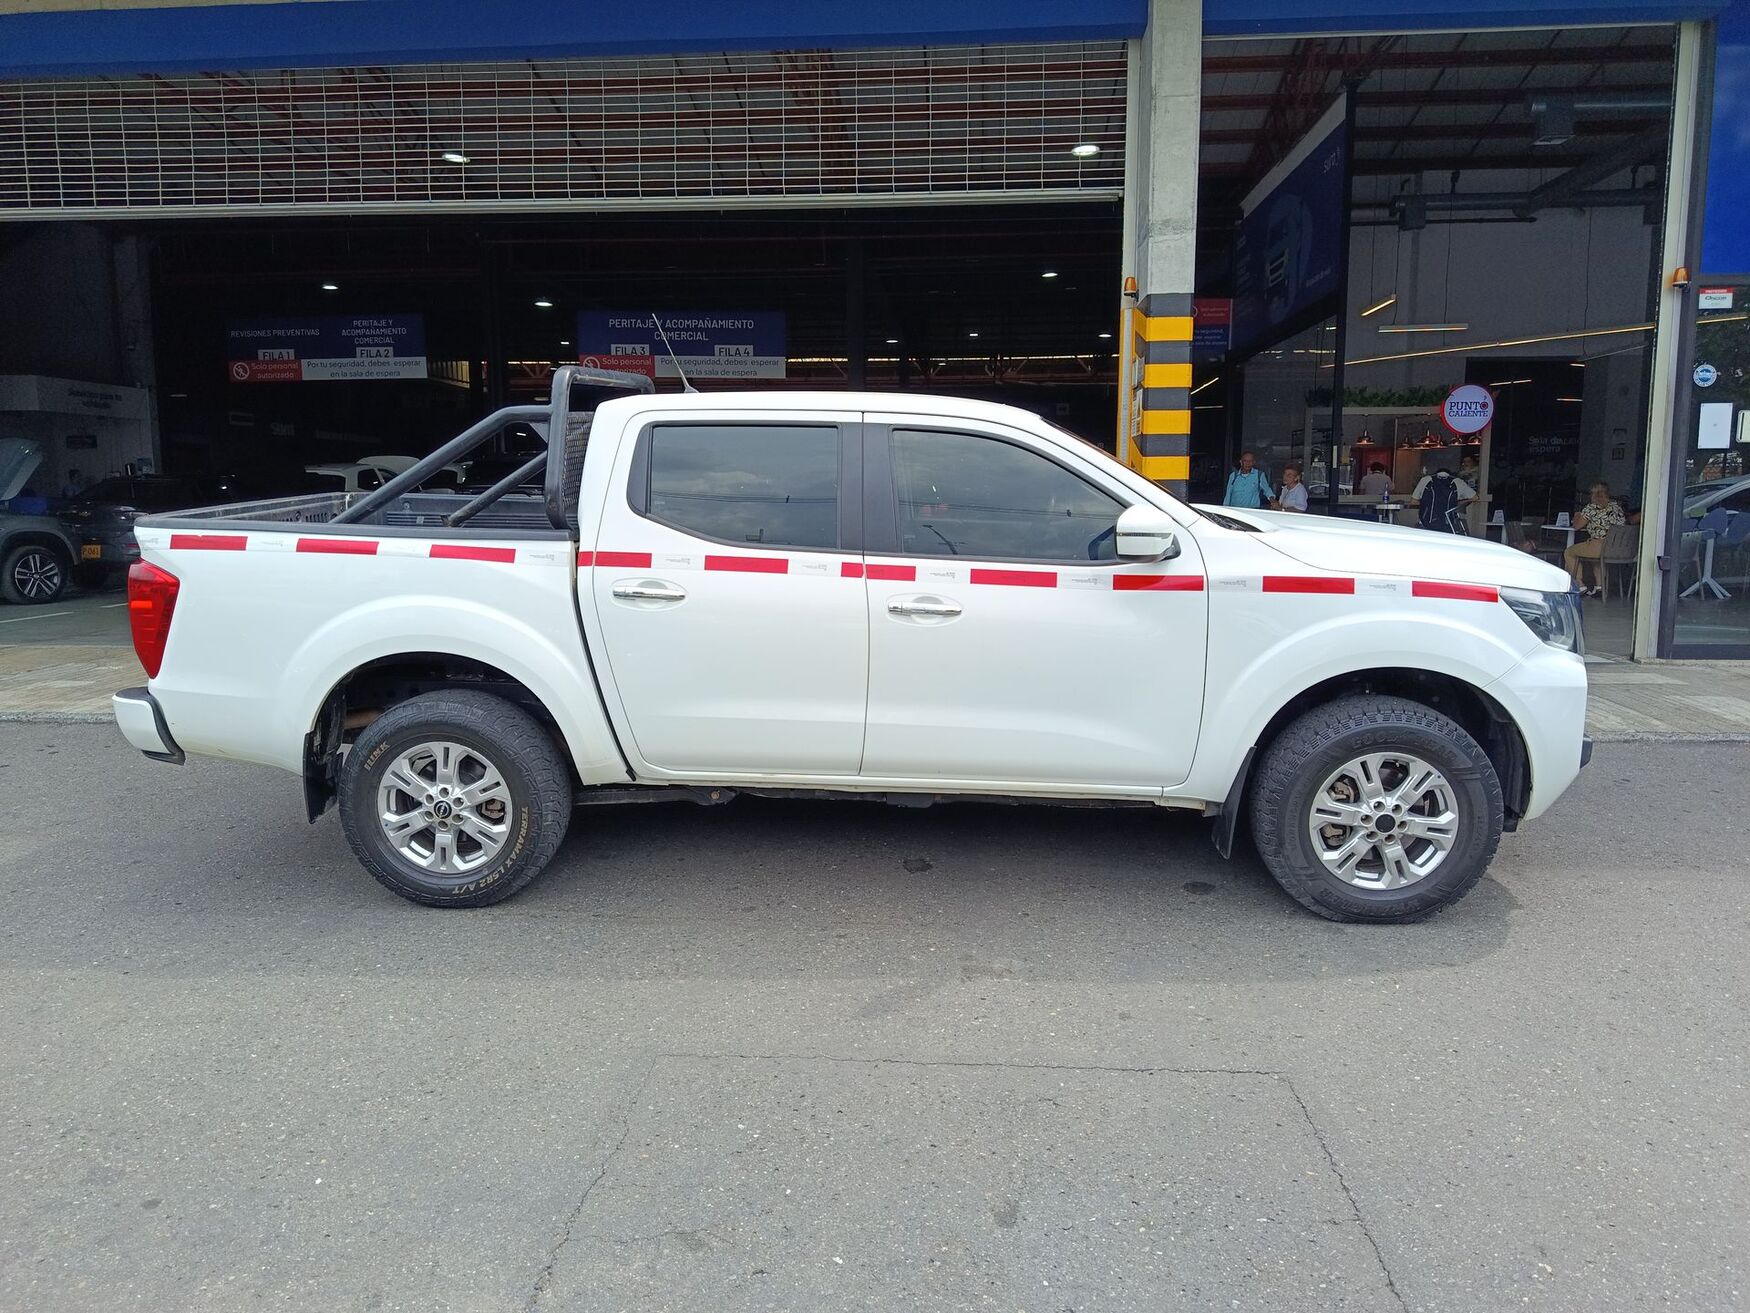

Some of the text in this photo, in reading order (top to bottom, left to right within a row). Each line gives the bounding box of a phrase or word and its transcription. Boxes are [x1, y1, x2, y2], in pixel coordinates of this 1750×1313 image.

[609, 319, 654, 328] PERITAJE
[665, 317, 754, 329] ACOMPAÑAMIENTO
[272, 328, 320, 336] PREVENTIVAS
[654, 331, 709, 341] COMERCIAL
[354, 337, 395, 345] COMERCIAL
[360, 350, 390, 358] FILA 2
[615, 346, 646, 355] FILA 3
[719, 347, 750, 356] FILA 4
[263, 352, 284, 360] FILA
[369, 360, 390, 368] debes
[393, 360, 421, 368] esperar
[618, 357, 651, 366] personal
[724, 357, 746, 366] debes
[751, 358, 779, 368] esperar
[251, 362, 298, 371] Solo personal
[257, 371, 294, 379] autorizado
[376, 370, 400, 379] espera
[732, 369, 757, 378] espera
[1449, 401, 1489, 411] PUNTO
[504, 806, 529, 868] TERRAMAX
[479, 865, 505, 888] LSR2
